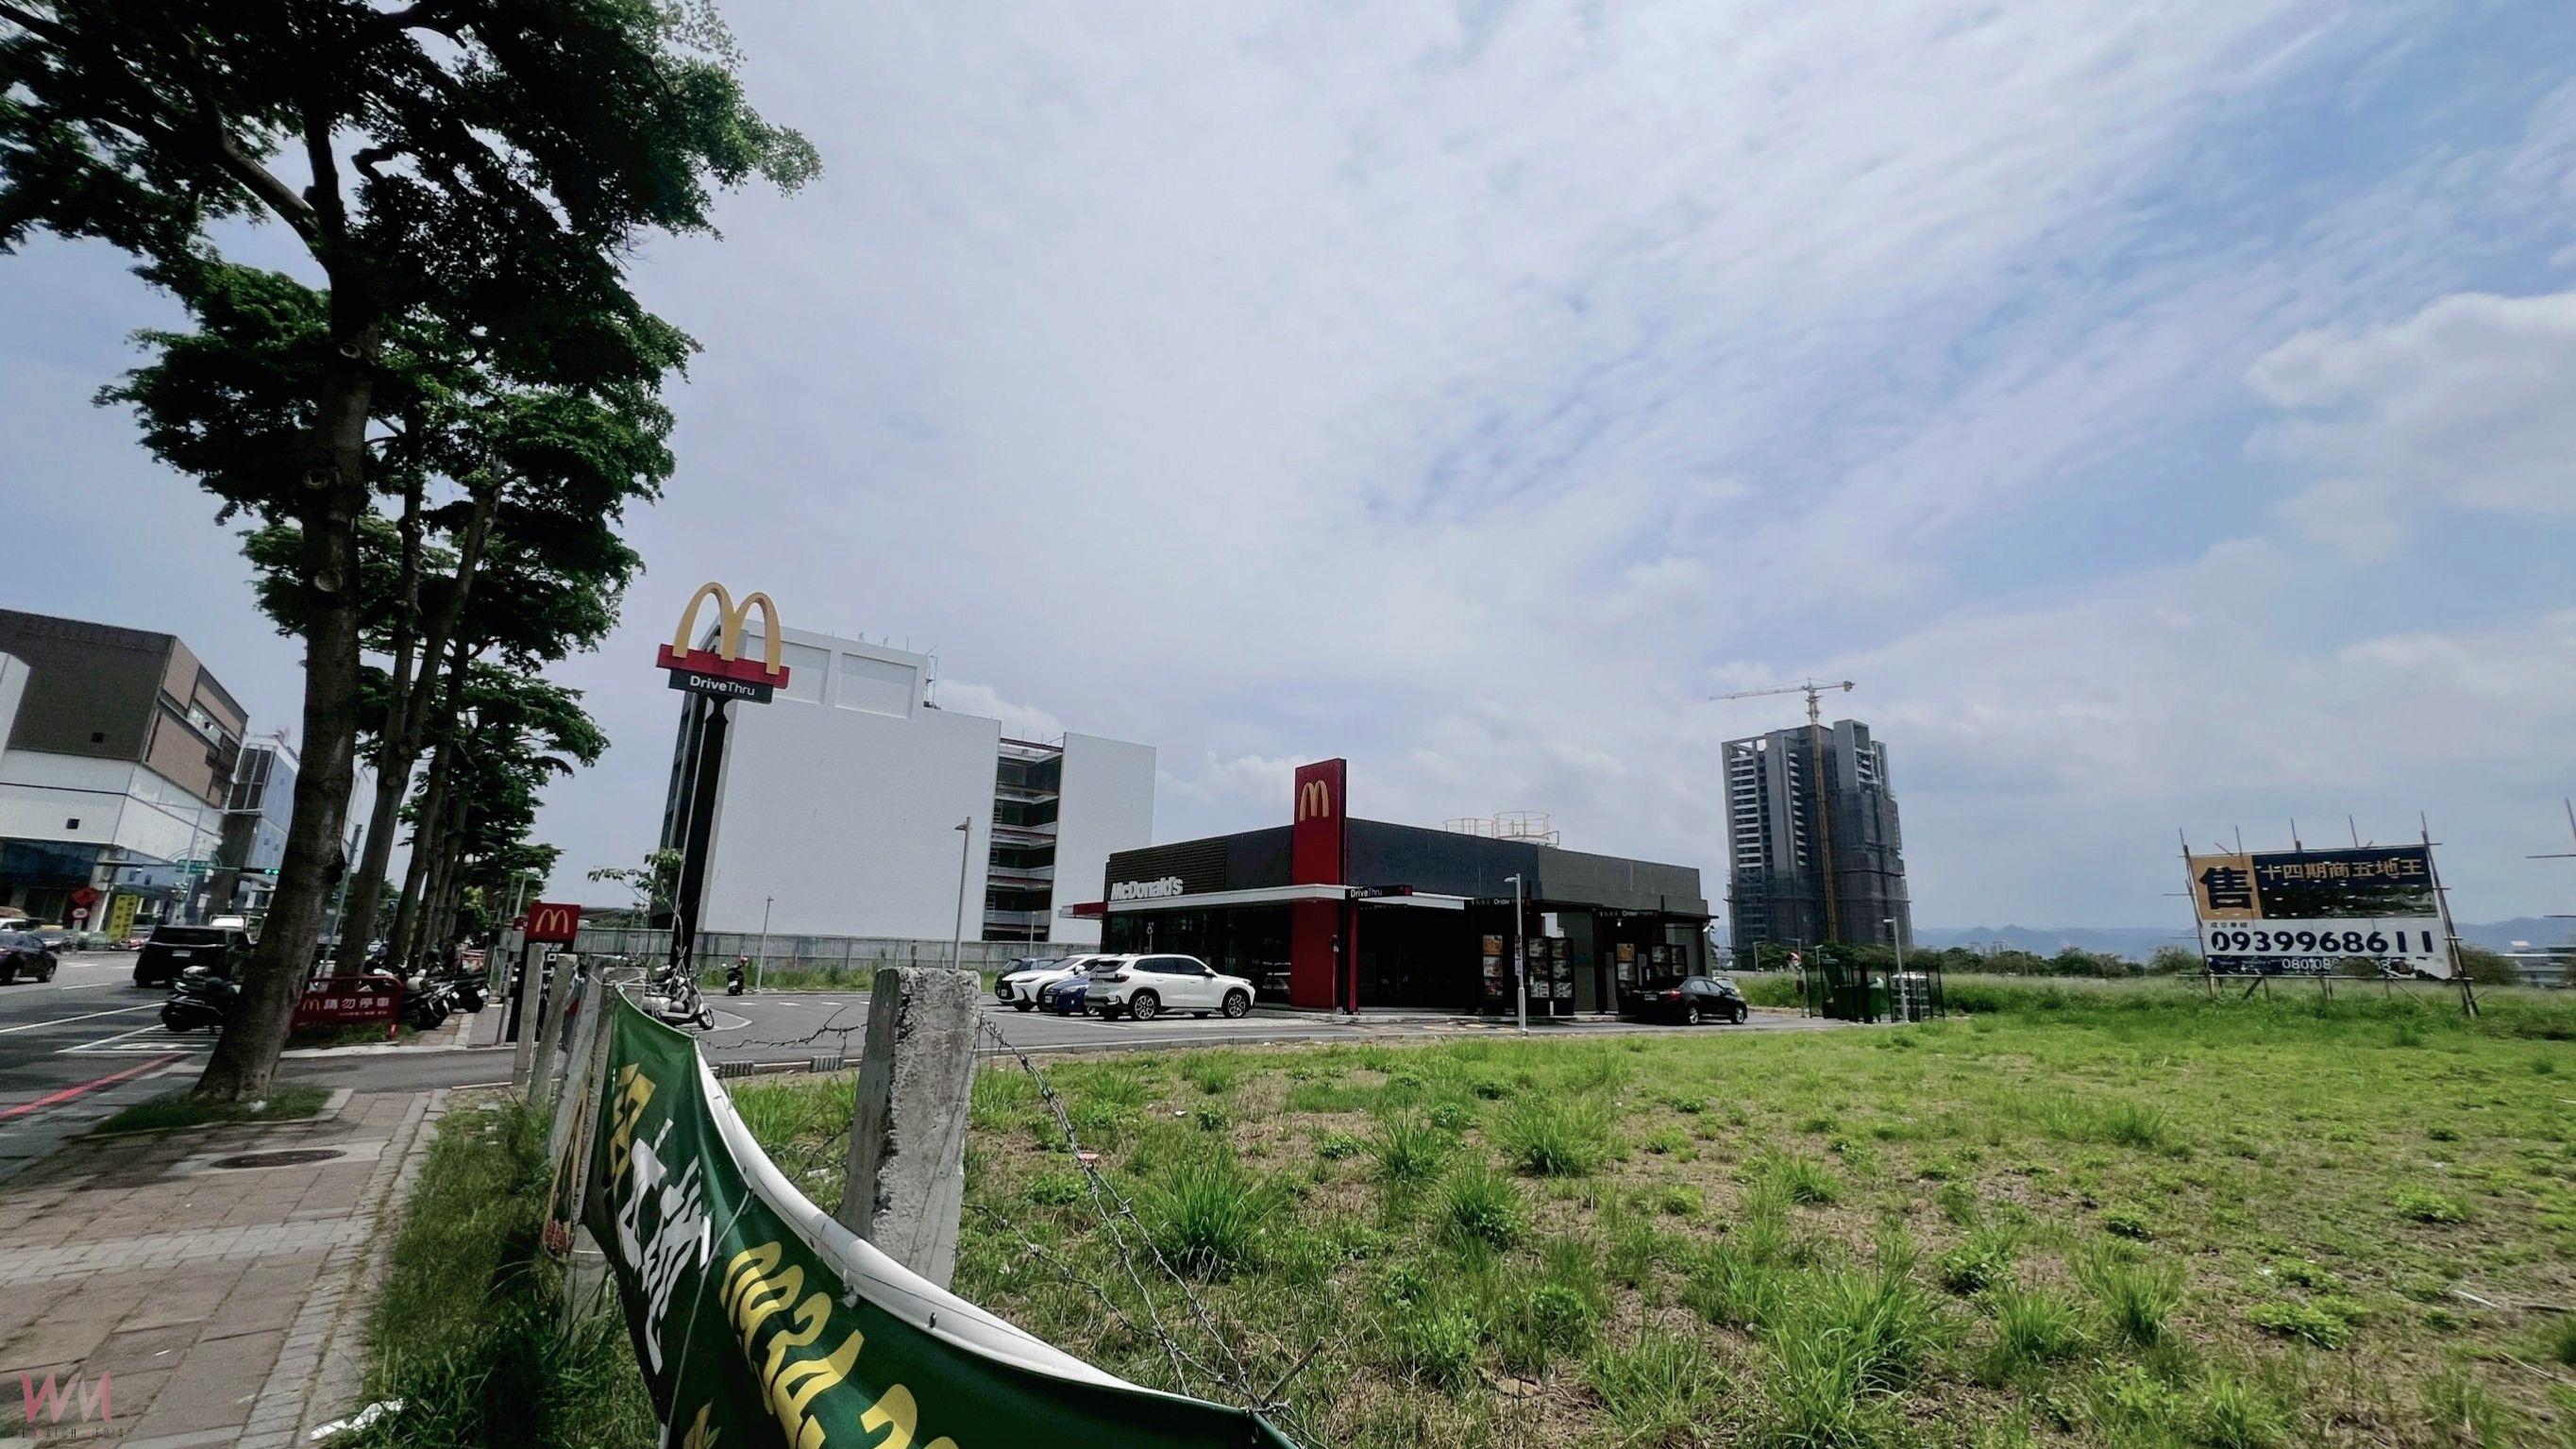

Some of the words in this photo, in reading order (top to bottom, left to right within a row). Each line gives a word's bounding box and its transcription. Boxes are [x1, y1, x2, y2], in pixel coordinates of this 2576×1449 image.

[2261, 858, 2426, 880] 十四期商五地王
[1110, 876, 1184, 901] McDonald's
[2199, 866, 2253, 909] 售
[2210, 930, 2433, 953] 0939968611
